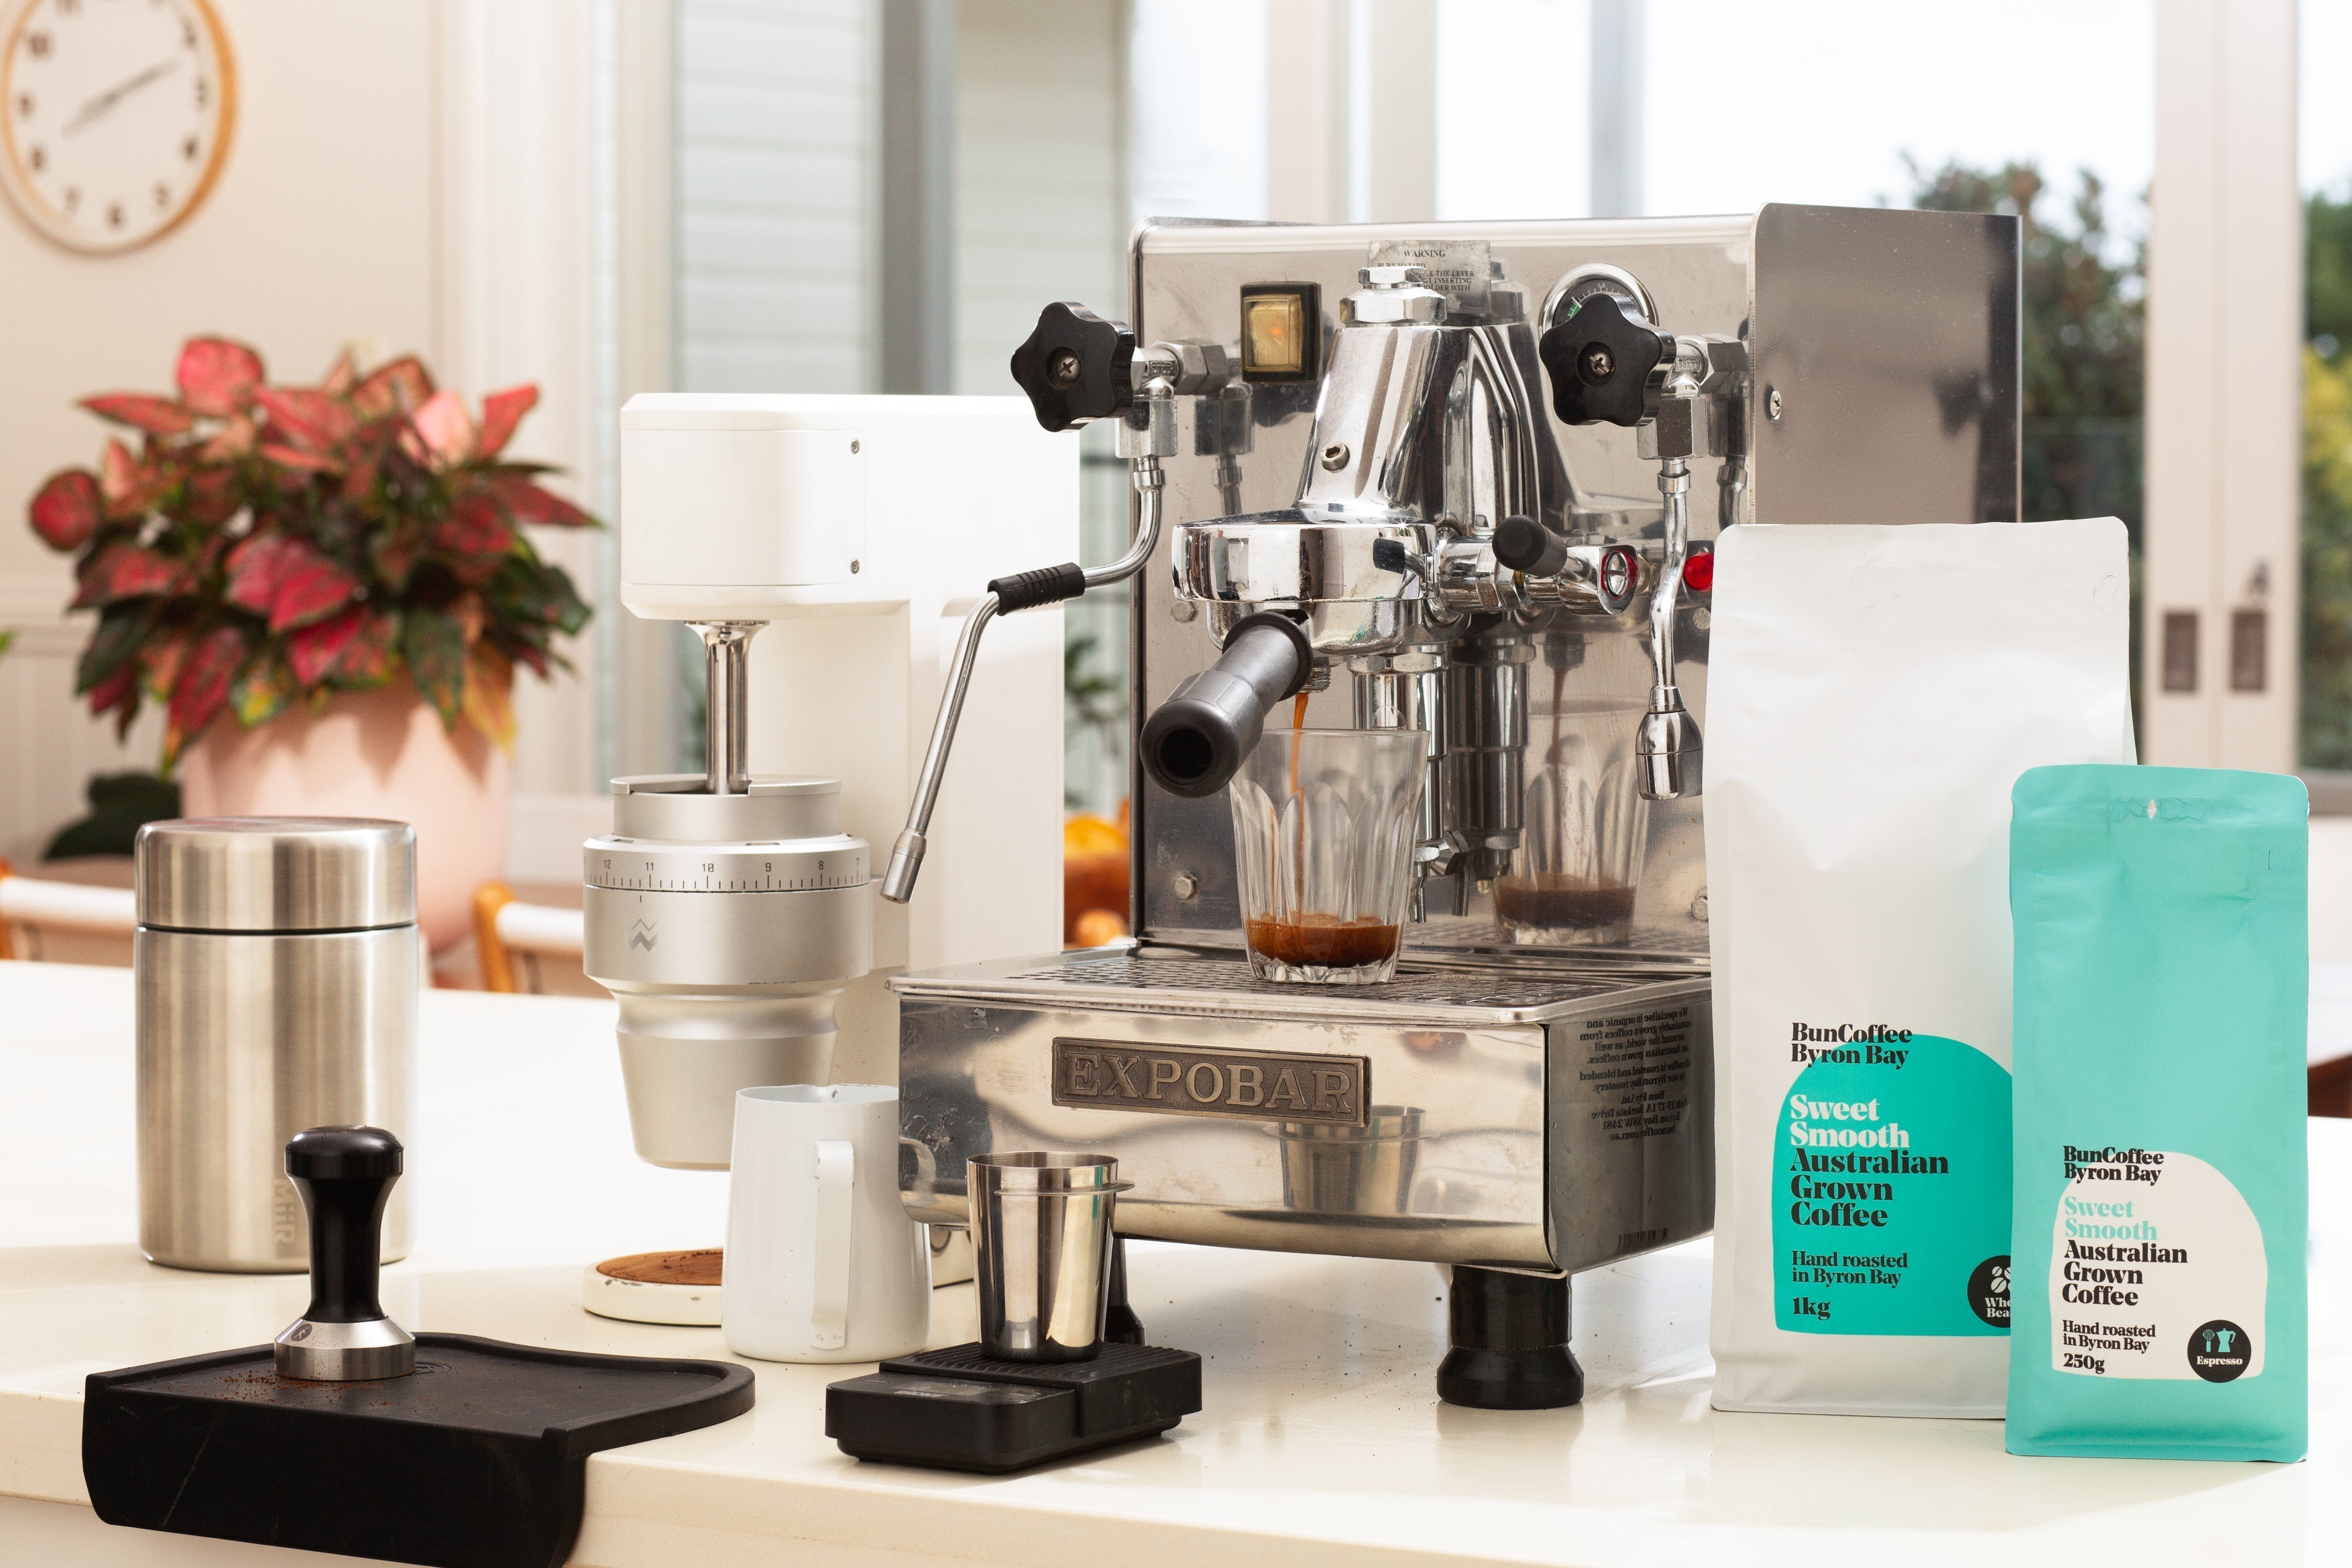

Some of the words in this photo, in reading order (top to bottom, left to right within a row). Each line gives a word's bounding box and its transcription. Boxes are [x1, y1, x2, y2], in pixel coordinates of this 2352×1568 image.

[604, 859, 611, 869] 12
[645, 862, 653, 871] 11
[702, 863, 714, 872] 10
[765, 862, 771, 872] 9
[819, 861, 824, 870] 8
[856, 858, 859, 866] 7
[1791, 1022, 1912, 1043] BunCoffee
[1791, 1043, 1861, 1068] Byron
[1865, 1045, 1909, 1070] Bay
[1063, 1052, 1352, 1114] EXPOBAR
[1790, 1094, 1880, 1121] Sweet
[1790, 1121, 1910, 1148] Smooth
[1790, 1148, 1949, 1174] Australian
[2063, 1145, 2164, 1165] BunCoffee
[2064, 1163, 2122, 1184] Byron
[2125, 1165, 2162, 1186] Bay
[1791, 1174, 1894, 1201] Grown
[1791, 1201, 1888, 1227] Coffee
[2064, 1196, 2135, 1218] Sweet
[2065, 1218, 2158, 1240] Smooth
[1792, 1250, 1839, 1267] Hand
[1842, 1252, 1908, 1268] roasted
[2064, 1240, 2188, 1263] Australian
[1792, 1267, 1810, 1283] in
[1813, 1267, 1867, 1288] Byron
[1870, 1269, 1901, 1289] Bay
[2063, 1261, 2143, 1284] Grown
[2062, 1283, 2139, 1306] Coffee
[1792, 1296, 1831, 1321] 1kg
[2062, 1320, 2100, 1335] Hand
[2102, 1324, 2156, 1338] roasted
[2063, 1333, 2077, 1346] in
[2079, 1334, 2121, 1351] Byron
[2123, 1338, 2150, 1354] Bay
[2063, 1353, 2105, 1374] 250g
[2196, 1355, 2243, 1367] Espresso
